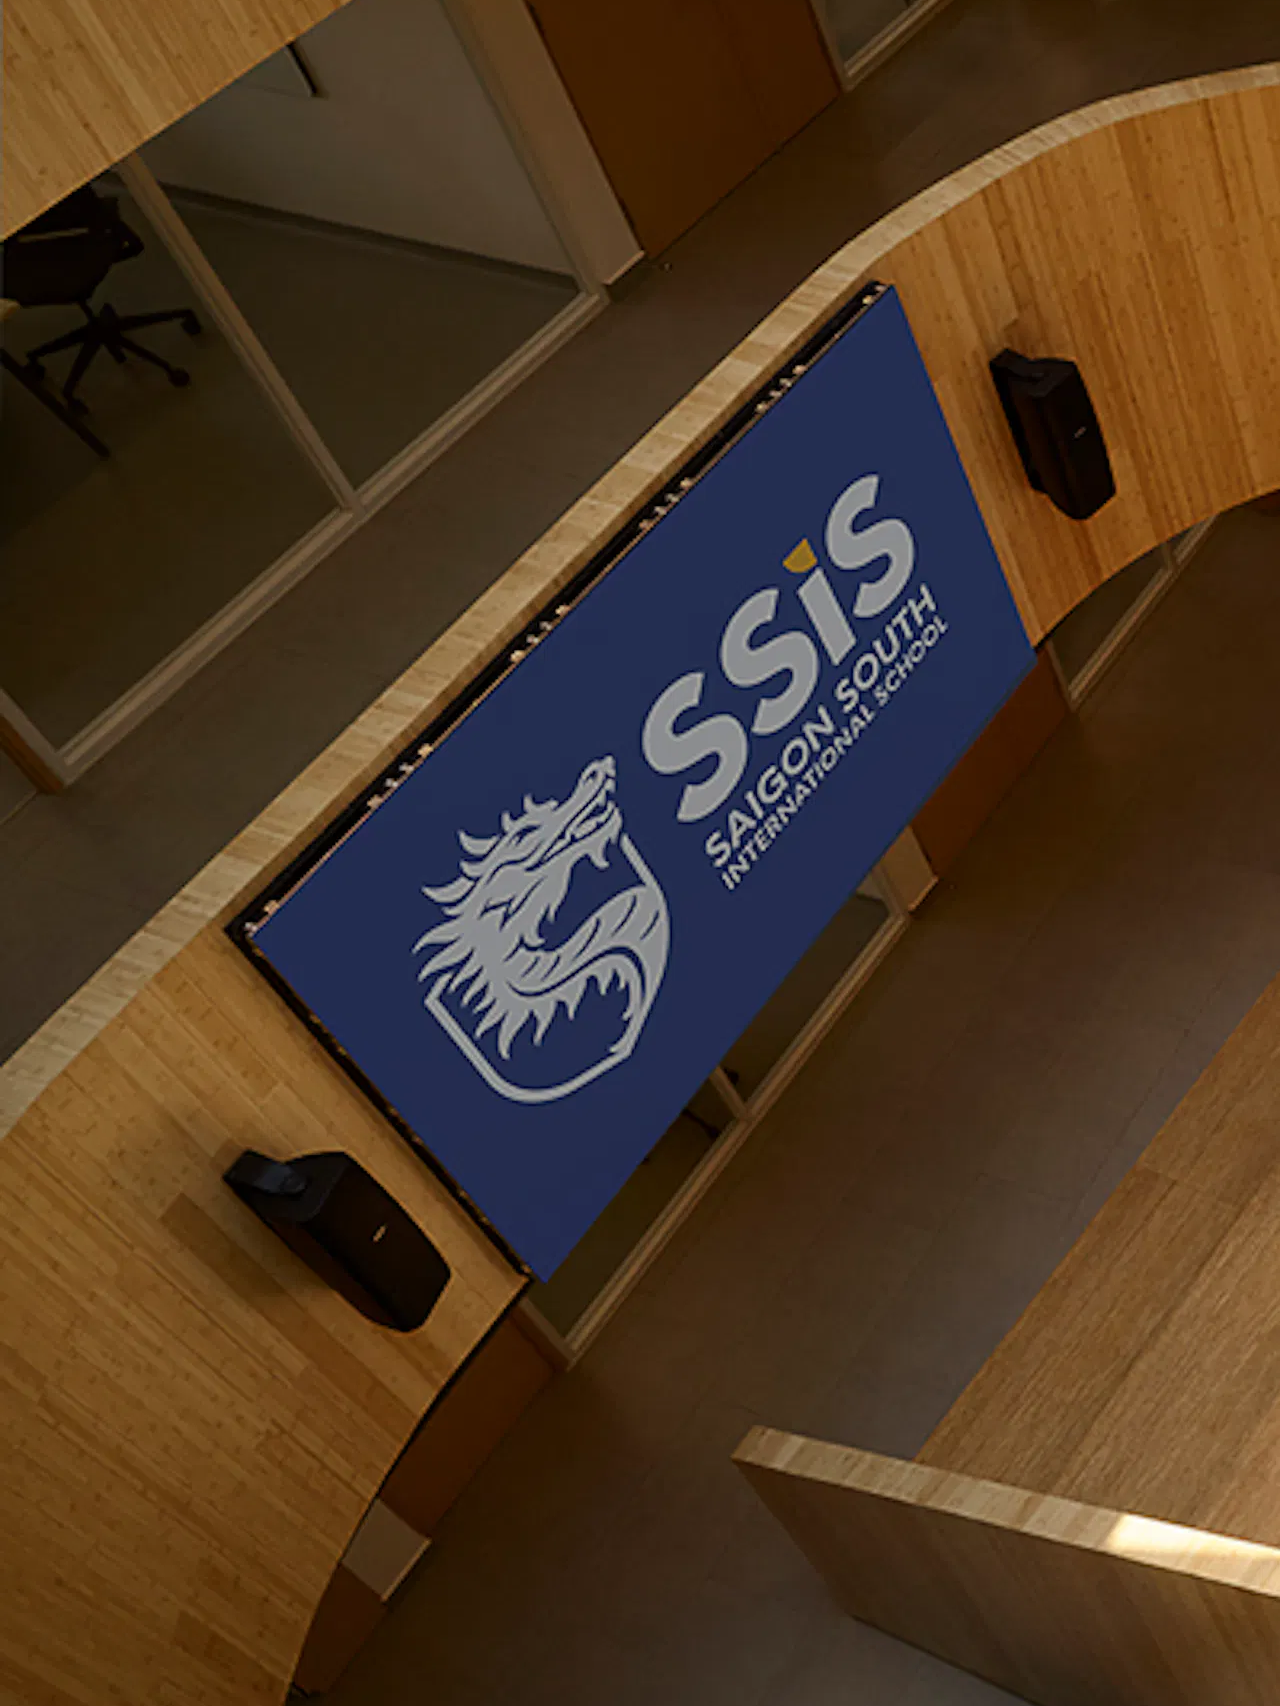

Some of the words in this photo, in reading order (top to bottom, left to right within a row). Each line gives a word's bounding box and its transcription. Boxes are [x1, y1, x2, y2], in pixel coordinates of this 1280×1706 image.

[704, 703, 835, 868] SAIGON
[834, 582, 938, 714] SOUTH
[720, 703, 876, 891] INTERNATIONAL
[872, 614, 949, 708] SCHOOL
